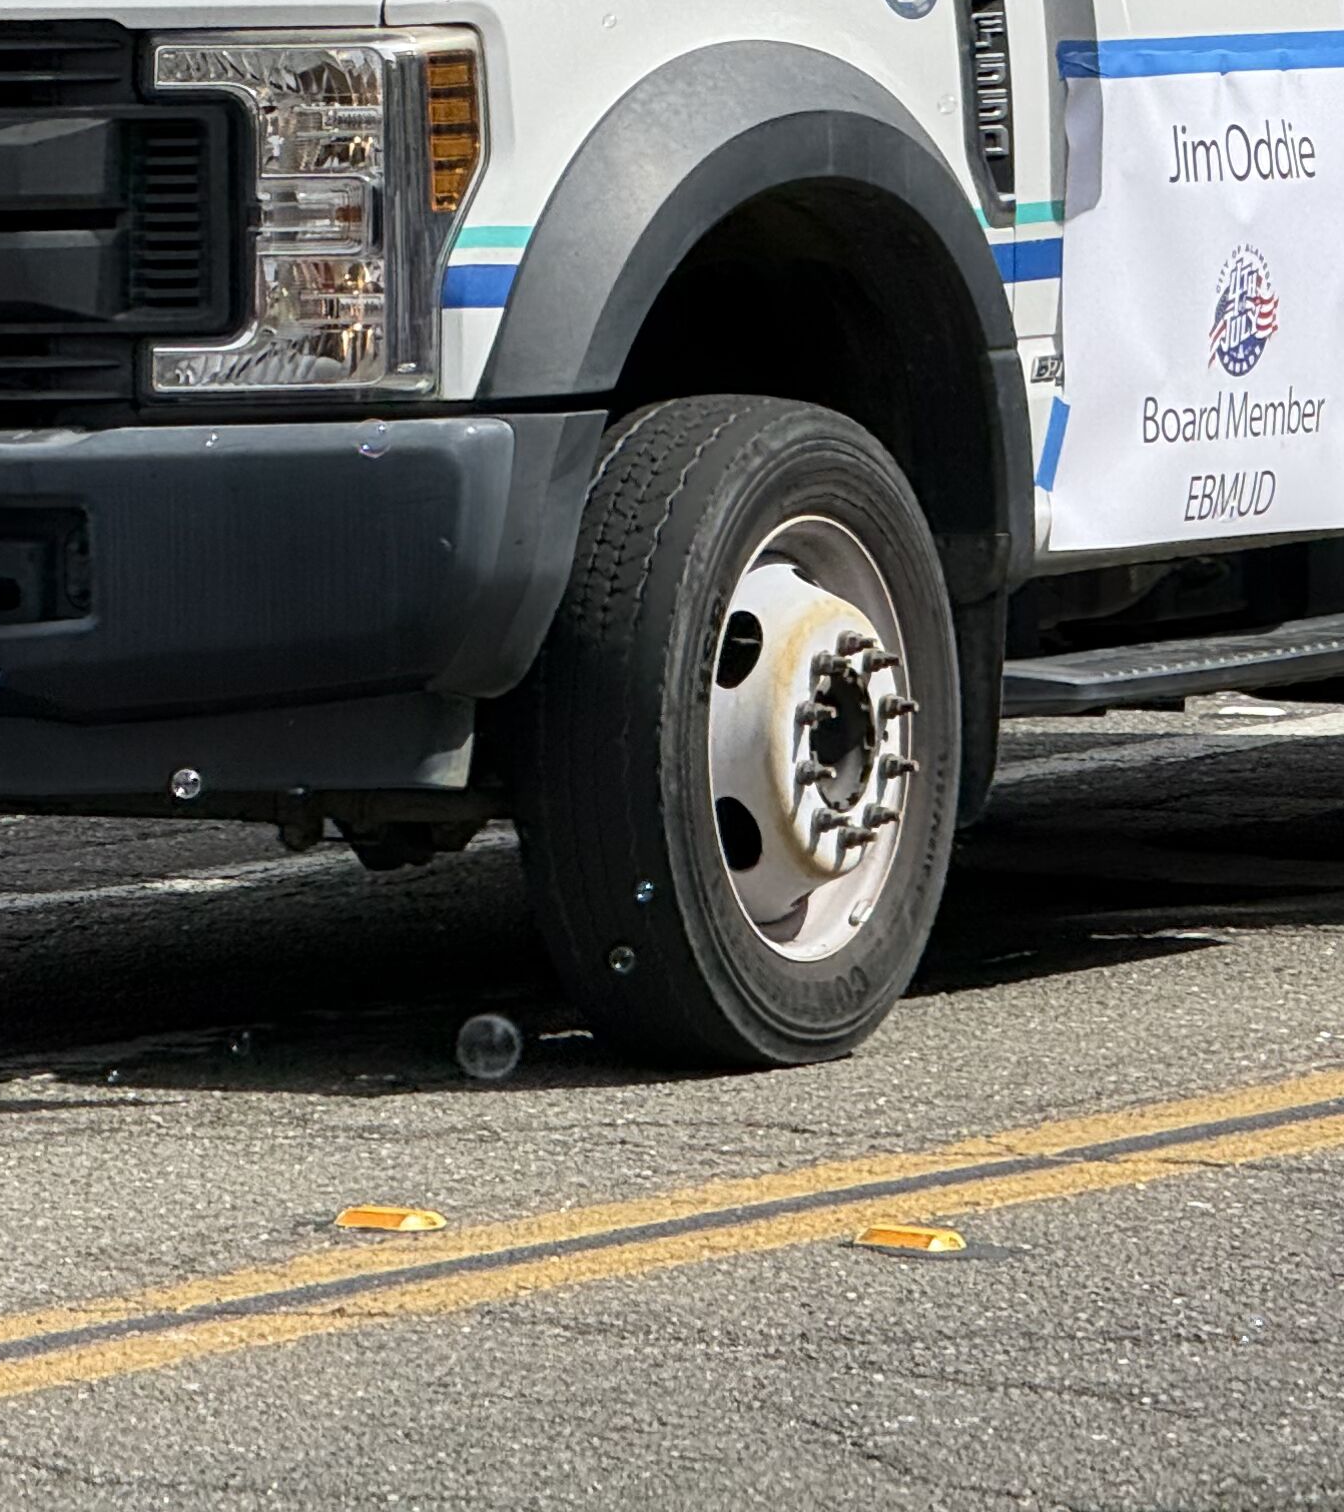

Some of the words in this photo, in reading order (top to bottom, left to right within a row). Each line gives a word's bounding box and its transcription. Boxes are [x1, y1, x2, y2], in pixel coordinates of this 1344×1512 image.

[1225, 118, 1316, 182] Oddie
[1143, 391, 1223, 444] Board
[1225, 385, 1326, 441] Member
[1183, 470, 1277, 522] EBMUD
